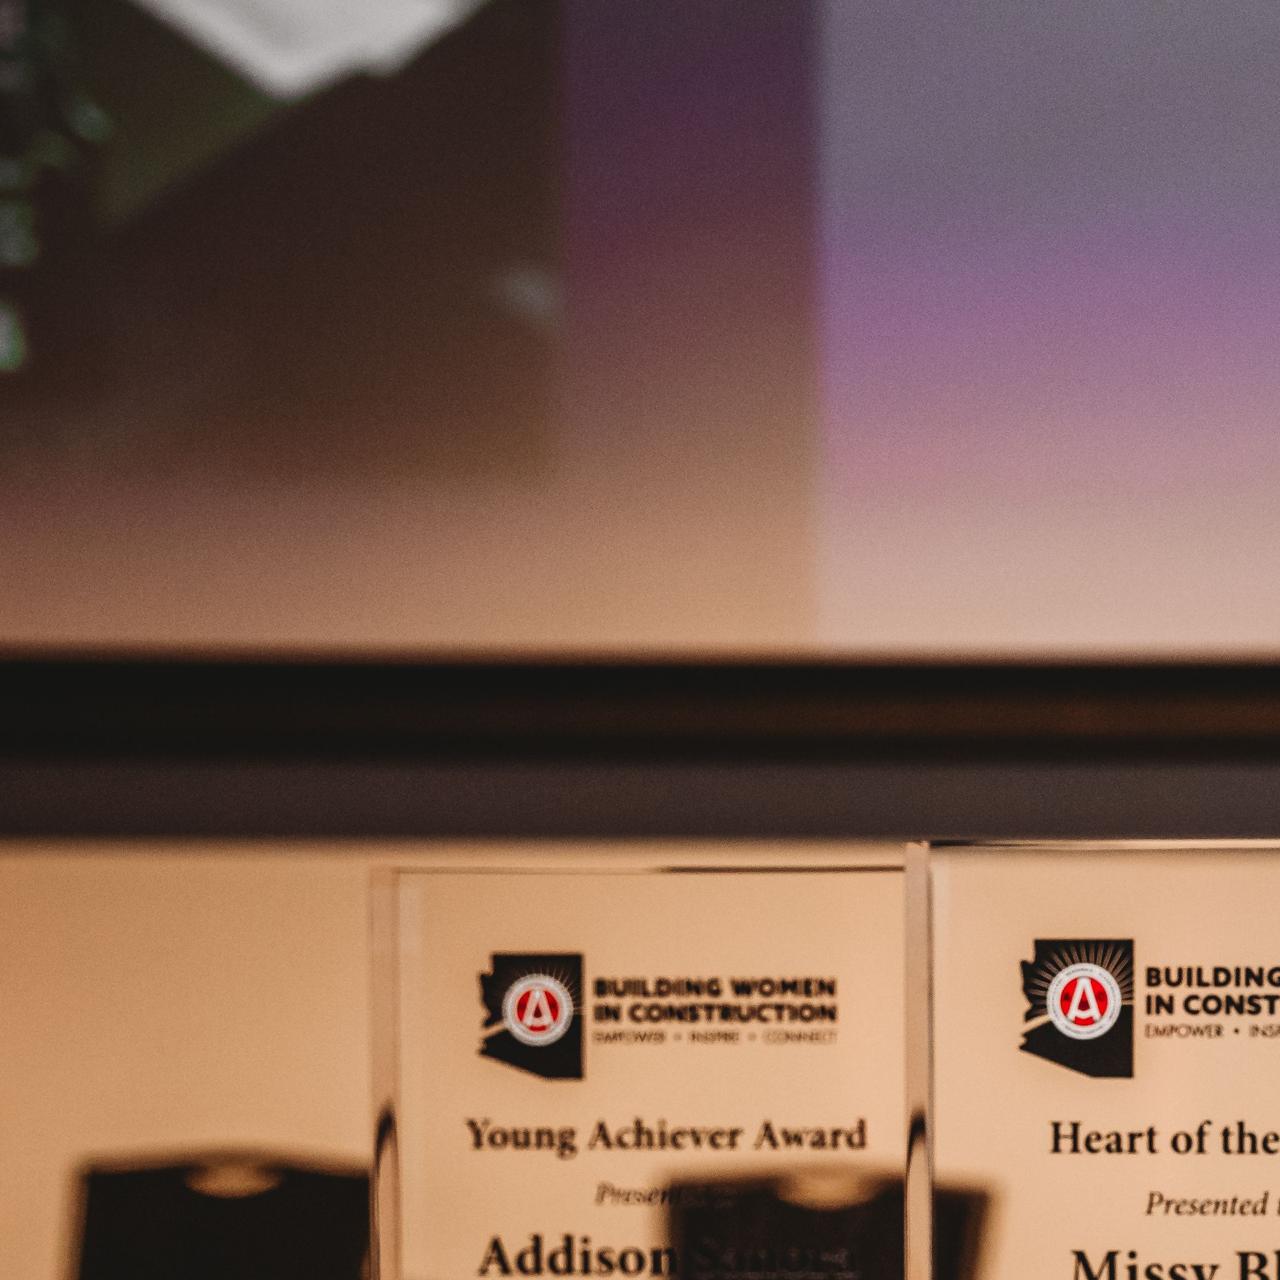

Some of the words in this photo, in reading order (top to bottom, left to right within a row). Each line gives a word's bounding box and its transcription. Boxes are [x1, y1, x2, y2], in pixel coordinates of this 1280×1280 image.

[593, 977, 721, 997] BUILDING
[731, 977, 836, 997] WOMEN
[628, 1004, 837, 1023] CONSTRUCTION
[1146, 995, 1175, 1016] IN
[1145, 1024, 1224, 1039] EMPOWER
[466, 1118, 579, 1160] Young
[588, 1118, 743, 1151] Achiever
[754, 1119, 868, 1151] Award
[1050, 1121, 1157, 1155] Heart
[1171, 1120, 1212, 1154] of
[1221, 1121, 1280, 1155] the
[1146, 1192, 1268, 1217] Presented
[479, 1234, 678, 1279] Addison
